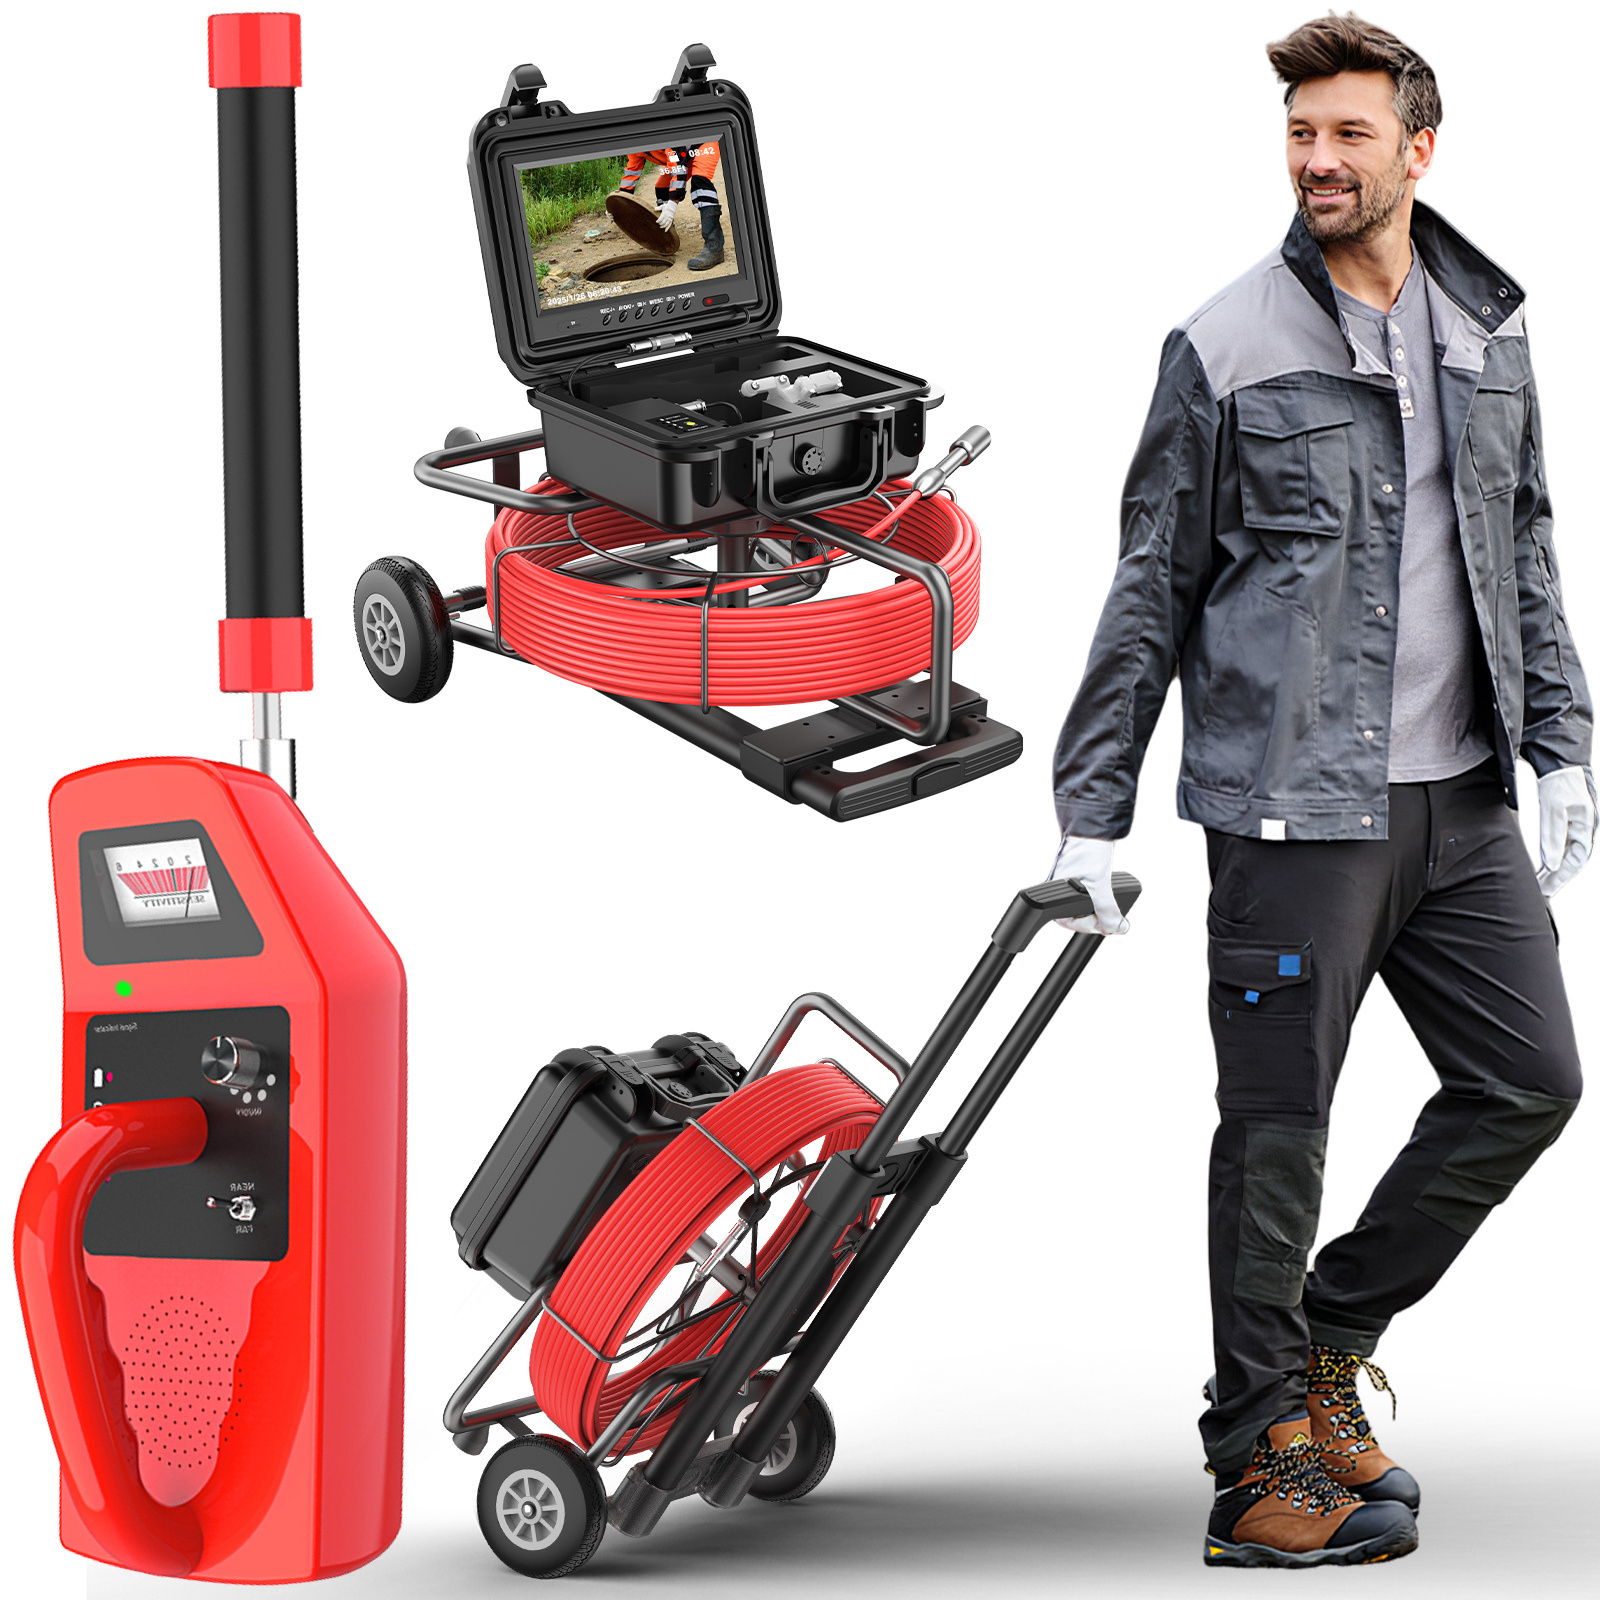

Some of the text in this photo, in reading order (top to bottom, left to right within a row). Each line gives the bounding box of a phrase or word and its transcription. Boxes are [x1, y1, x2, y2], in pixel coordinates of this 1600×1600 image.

[688, 146, 715, 158] 08:42
[659, 165, 687, 176] 36.8Ft
[547, 285, 623, 306] 2025/1/26 06:20:43
